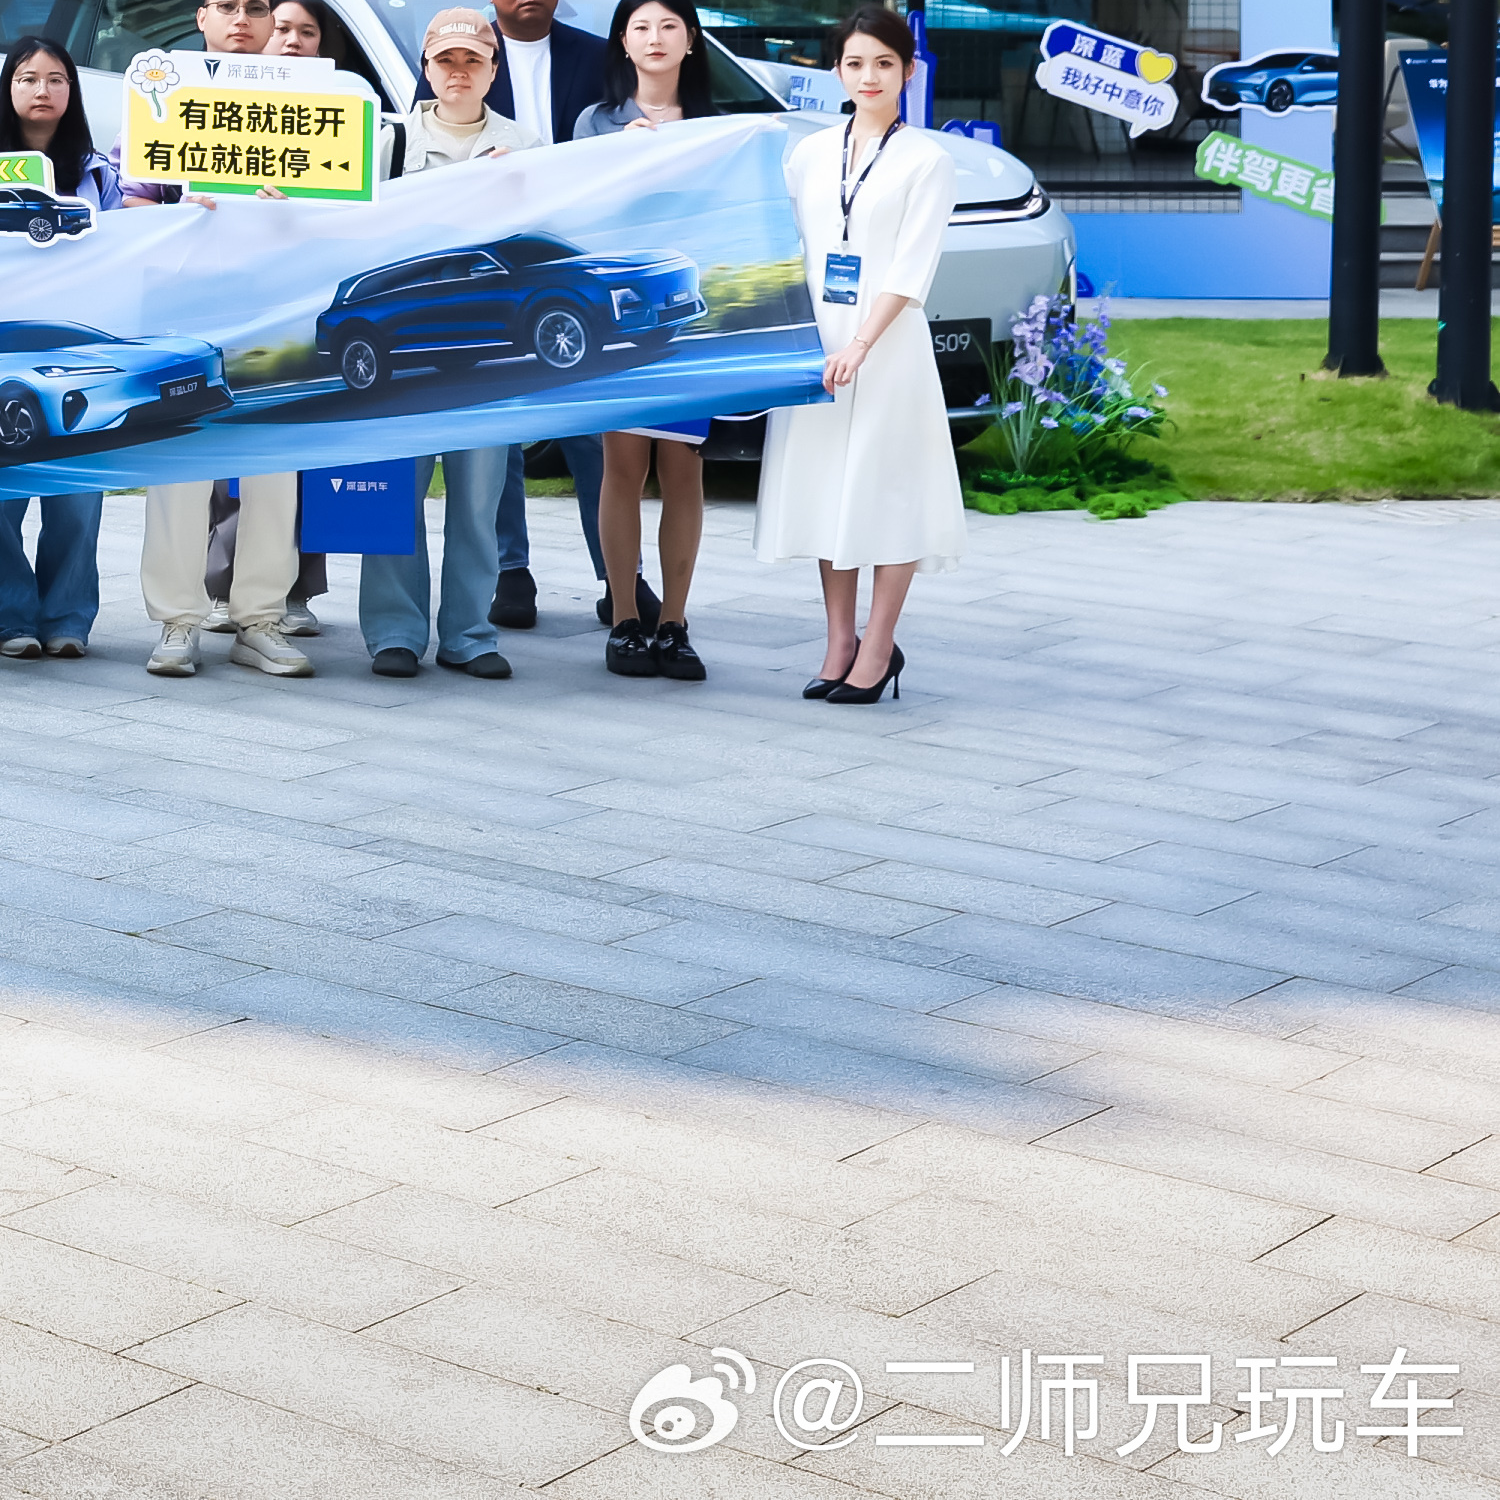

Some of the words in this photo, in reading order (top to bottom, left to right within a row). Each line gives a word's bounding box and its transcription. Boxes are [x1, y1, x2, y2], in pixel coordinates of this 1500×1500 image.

[1072, 32, 1127, 70] 深蓝
[227, 63, 292, 82] 深蓝汽车
[1060, 65, 1166, 118] 我好中意你
[178, 99, 346, 138] 有路就能开
[143, 139, 311, 179] 有位就能停
[933, 332, 972, 353] S09
